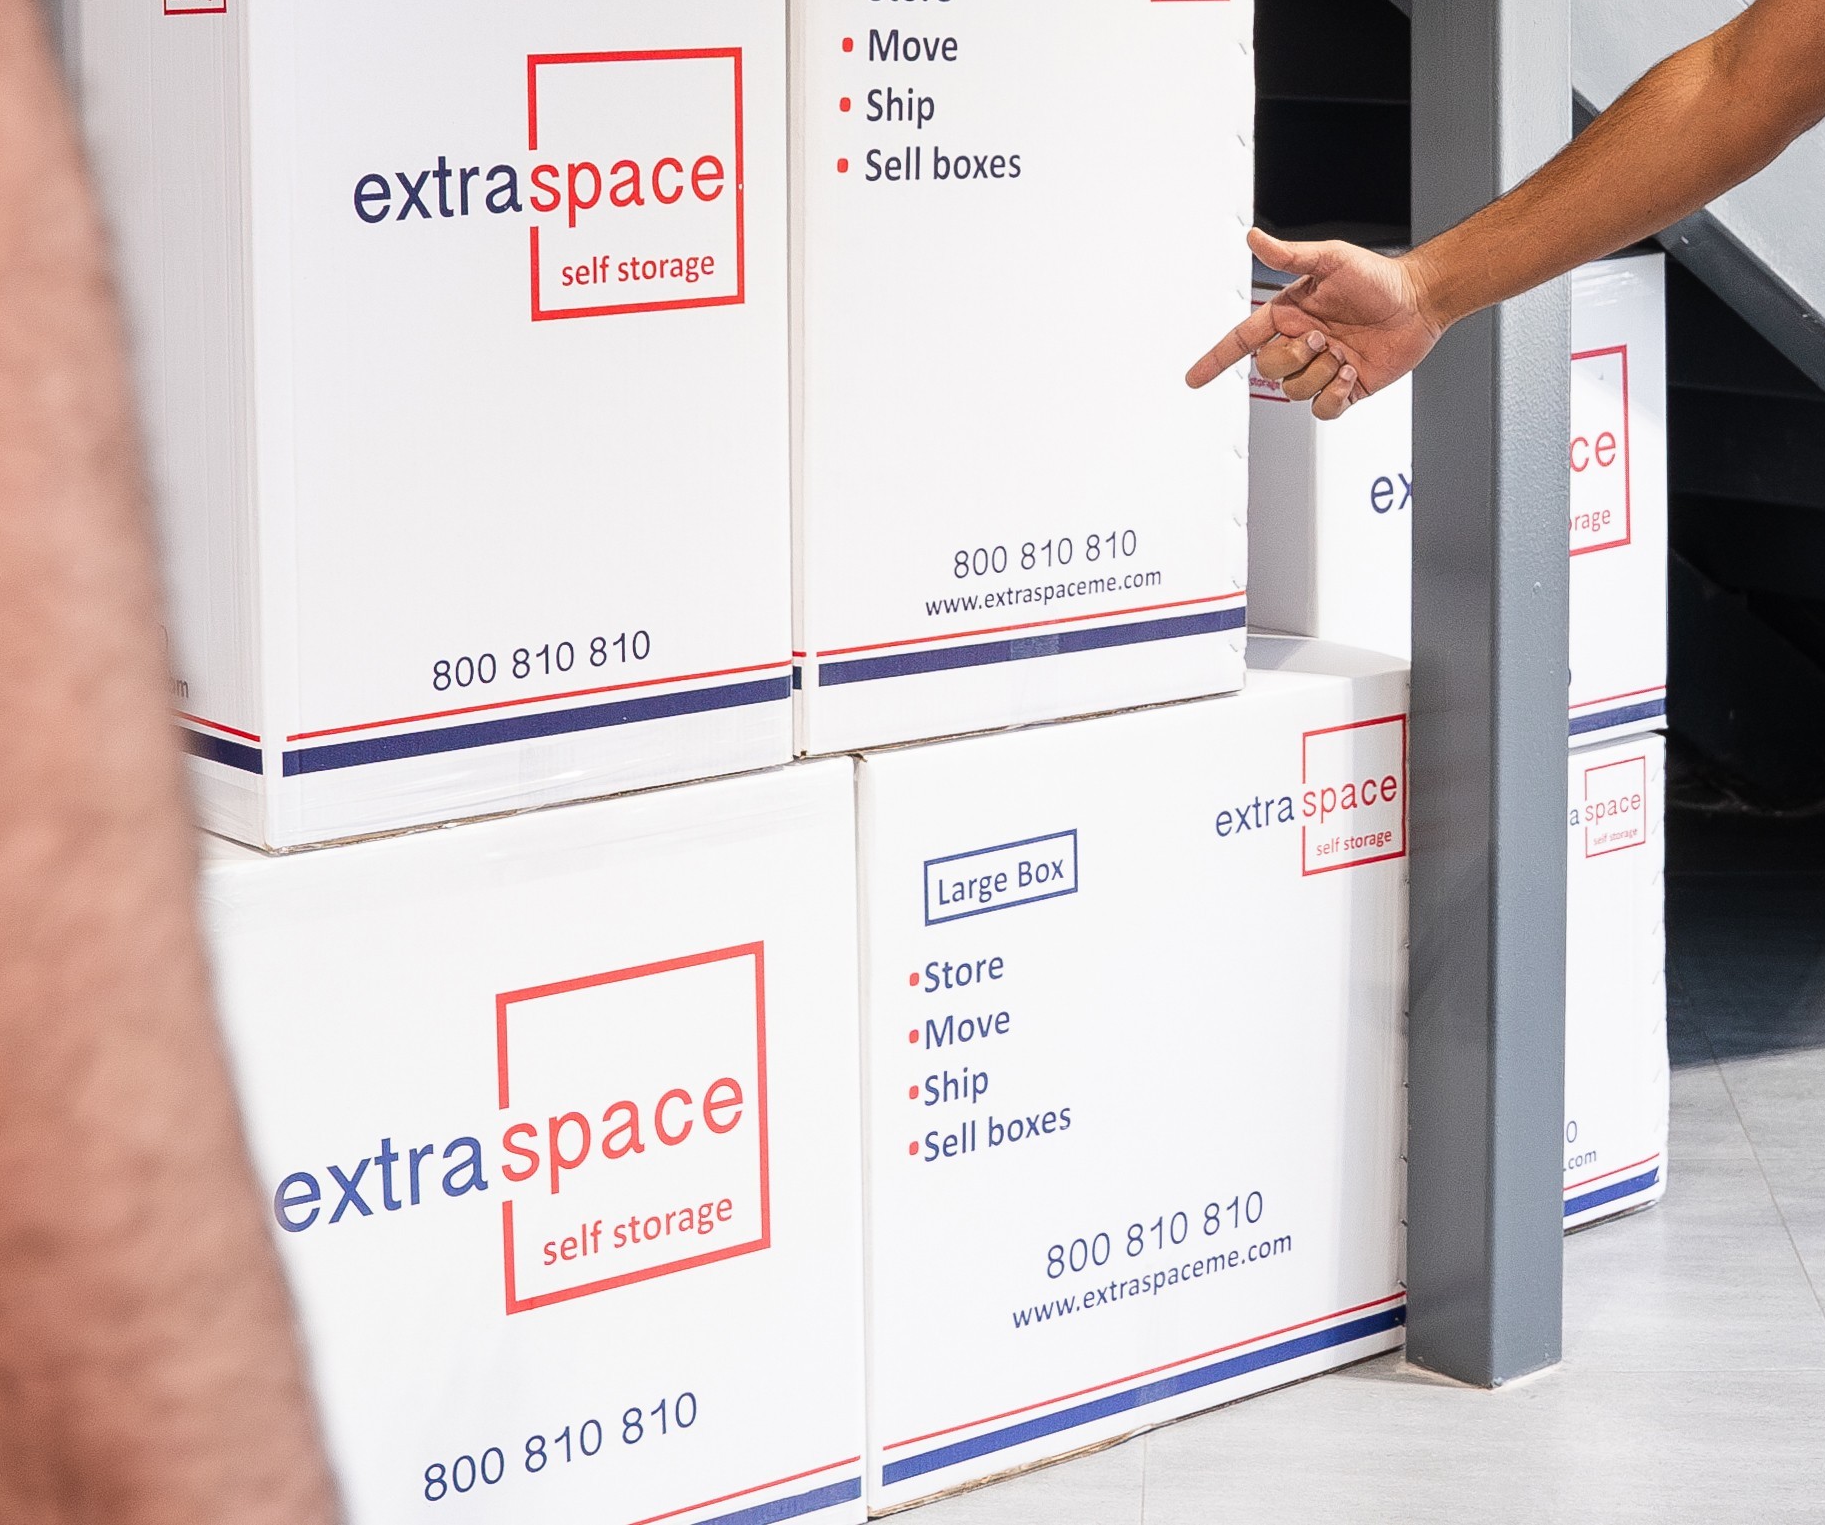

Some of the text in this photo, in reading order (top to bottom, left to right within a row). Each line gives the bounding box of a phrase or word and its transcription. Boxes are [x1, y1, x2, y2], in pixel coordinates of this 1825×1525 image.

[868, 28, 959, 62] Move
[866, 86, 935, 129] Ship
[865, 145, 1022, 182] Sell boxes
[561, 252, 715, 287] self storage
[1569, 509, 1611, 532] rage
[953, 529, 1137, 579] 800 810 810
[925, 568, 1162, 617] www.extraspaceme.com
[432, 630, 651, 692] 800 810 810
[1585, 793, 1641, 826] space
[1316, 830, 1393, 856] self storage
[939, 858, 1064, 904] Large Box
[924, 954, 1004, 994] Store
[925, 1009, 1010, 1050] Move
[924, 1065, 989, 1107] Ship
[924, 1104, 1071, 1163] Sell boxes
[543, 1196, 733, 1266] self storage
[1047, 1190, 1263, 1280] 800 810 810
[1012, 1233, 1293, 1330] www.extraspaceme.com
[424, 1391, 697, 1502] 800 810 810
